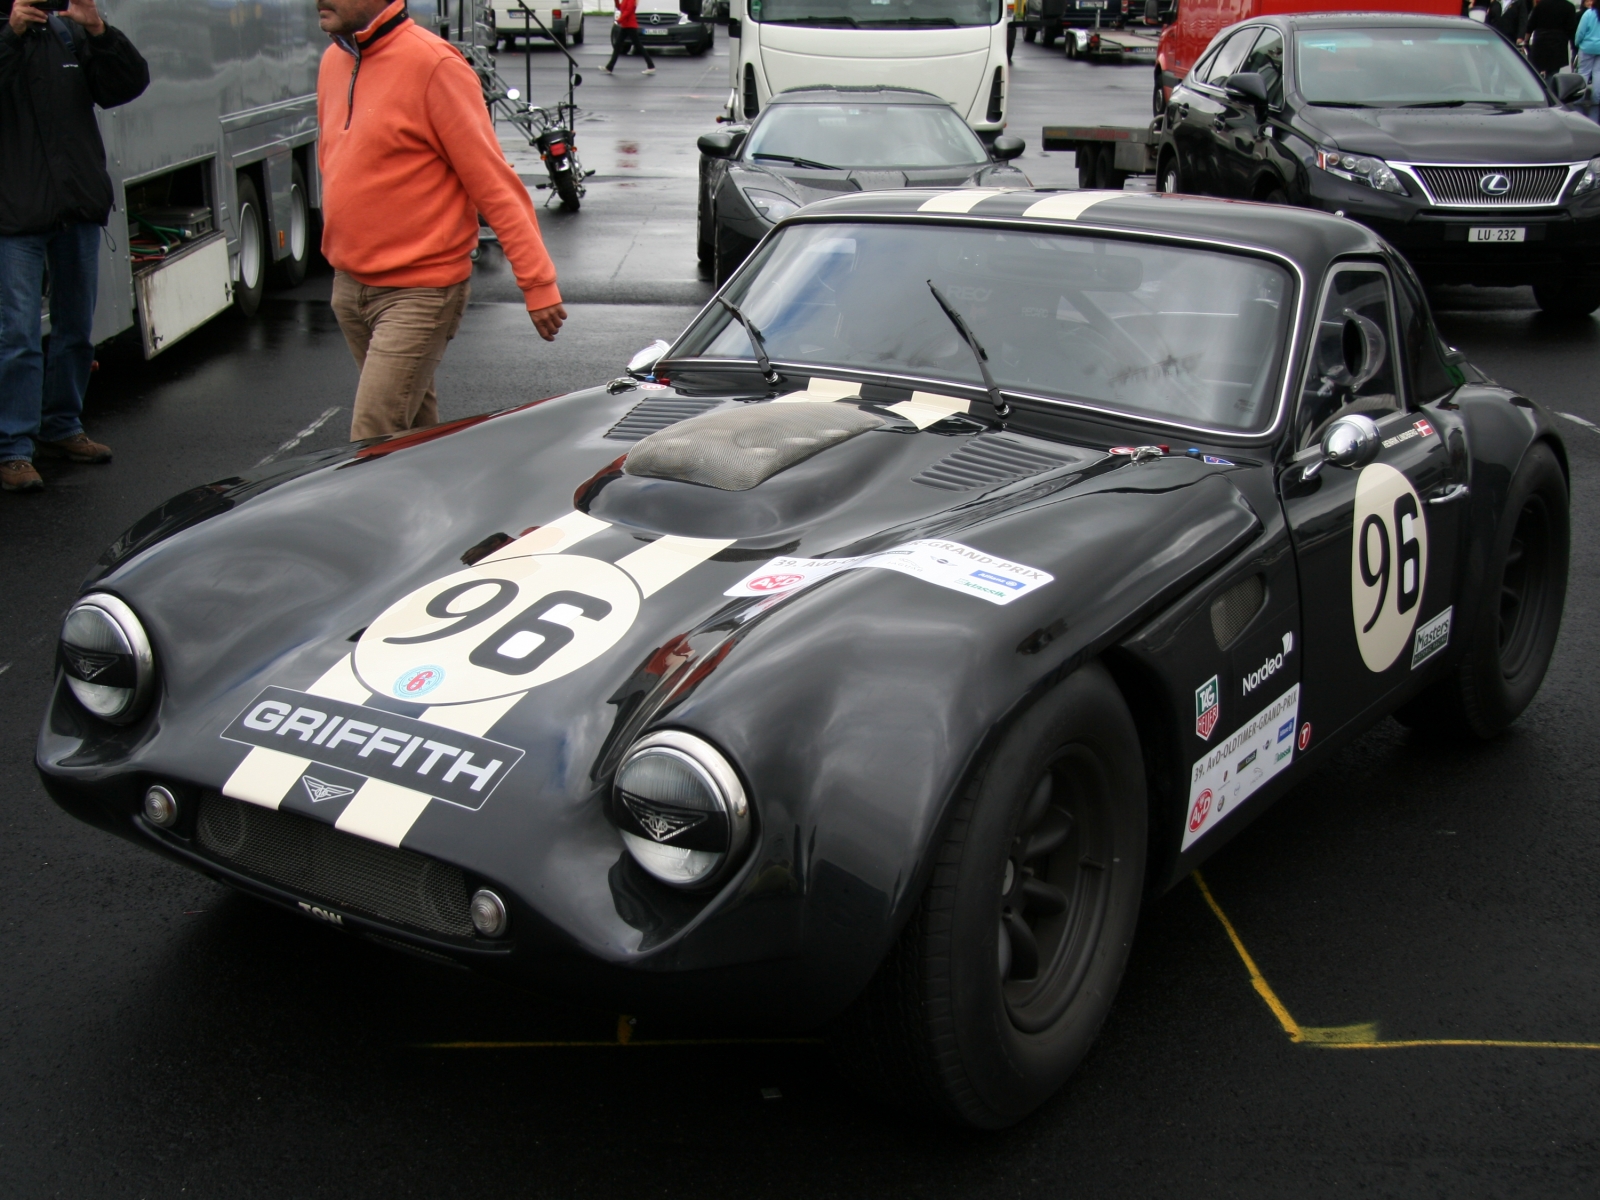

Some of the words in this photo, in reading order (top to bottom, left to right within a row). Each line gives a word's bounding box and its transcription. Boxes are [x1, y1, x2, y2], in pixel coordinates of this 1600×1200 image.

[1477, 229, 1491, 241] LU
[1497, 229, 1516, 241] 232
[1359, 492, 1420, 634] 96
[382, 578, 613, 676] 96
[1415, 619, 1449, 653] Masters
[1242, 652, 1283, 696] Nordea
[1200, 684, 1215, 712] TAG
[1197, 707, 1217, 735] HEUER
[243, 699, 503, 792] GRIFFITH
